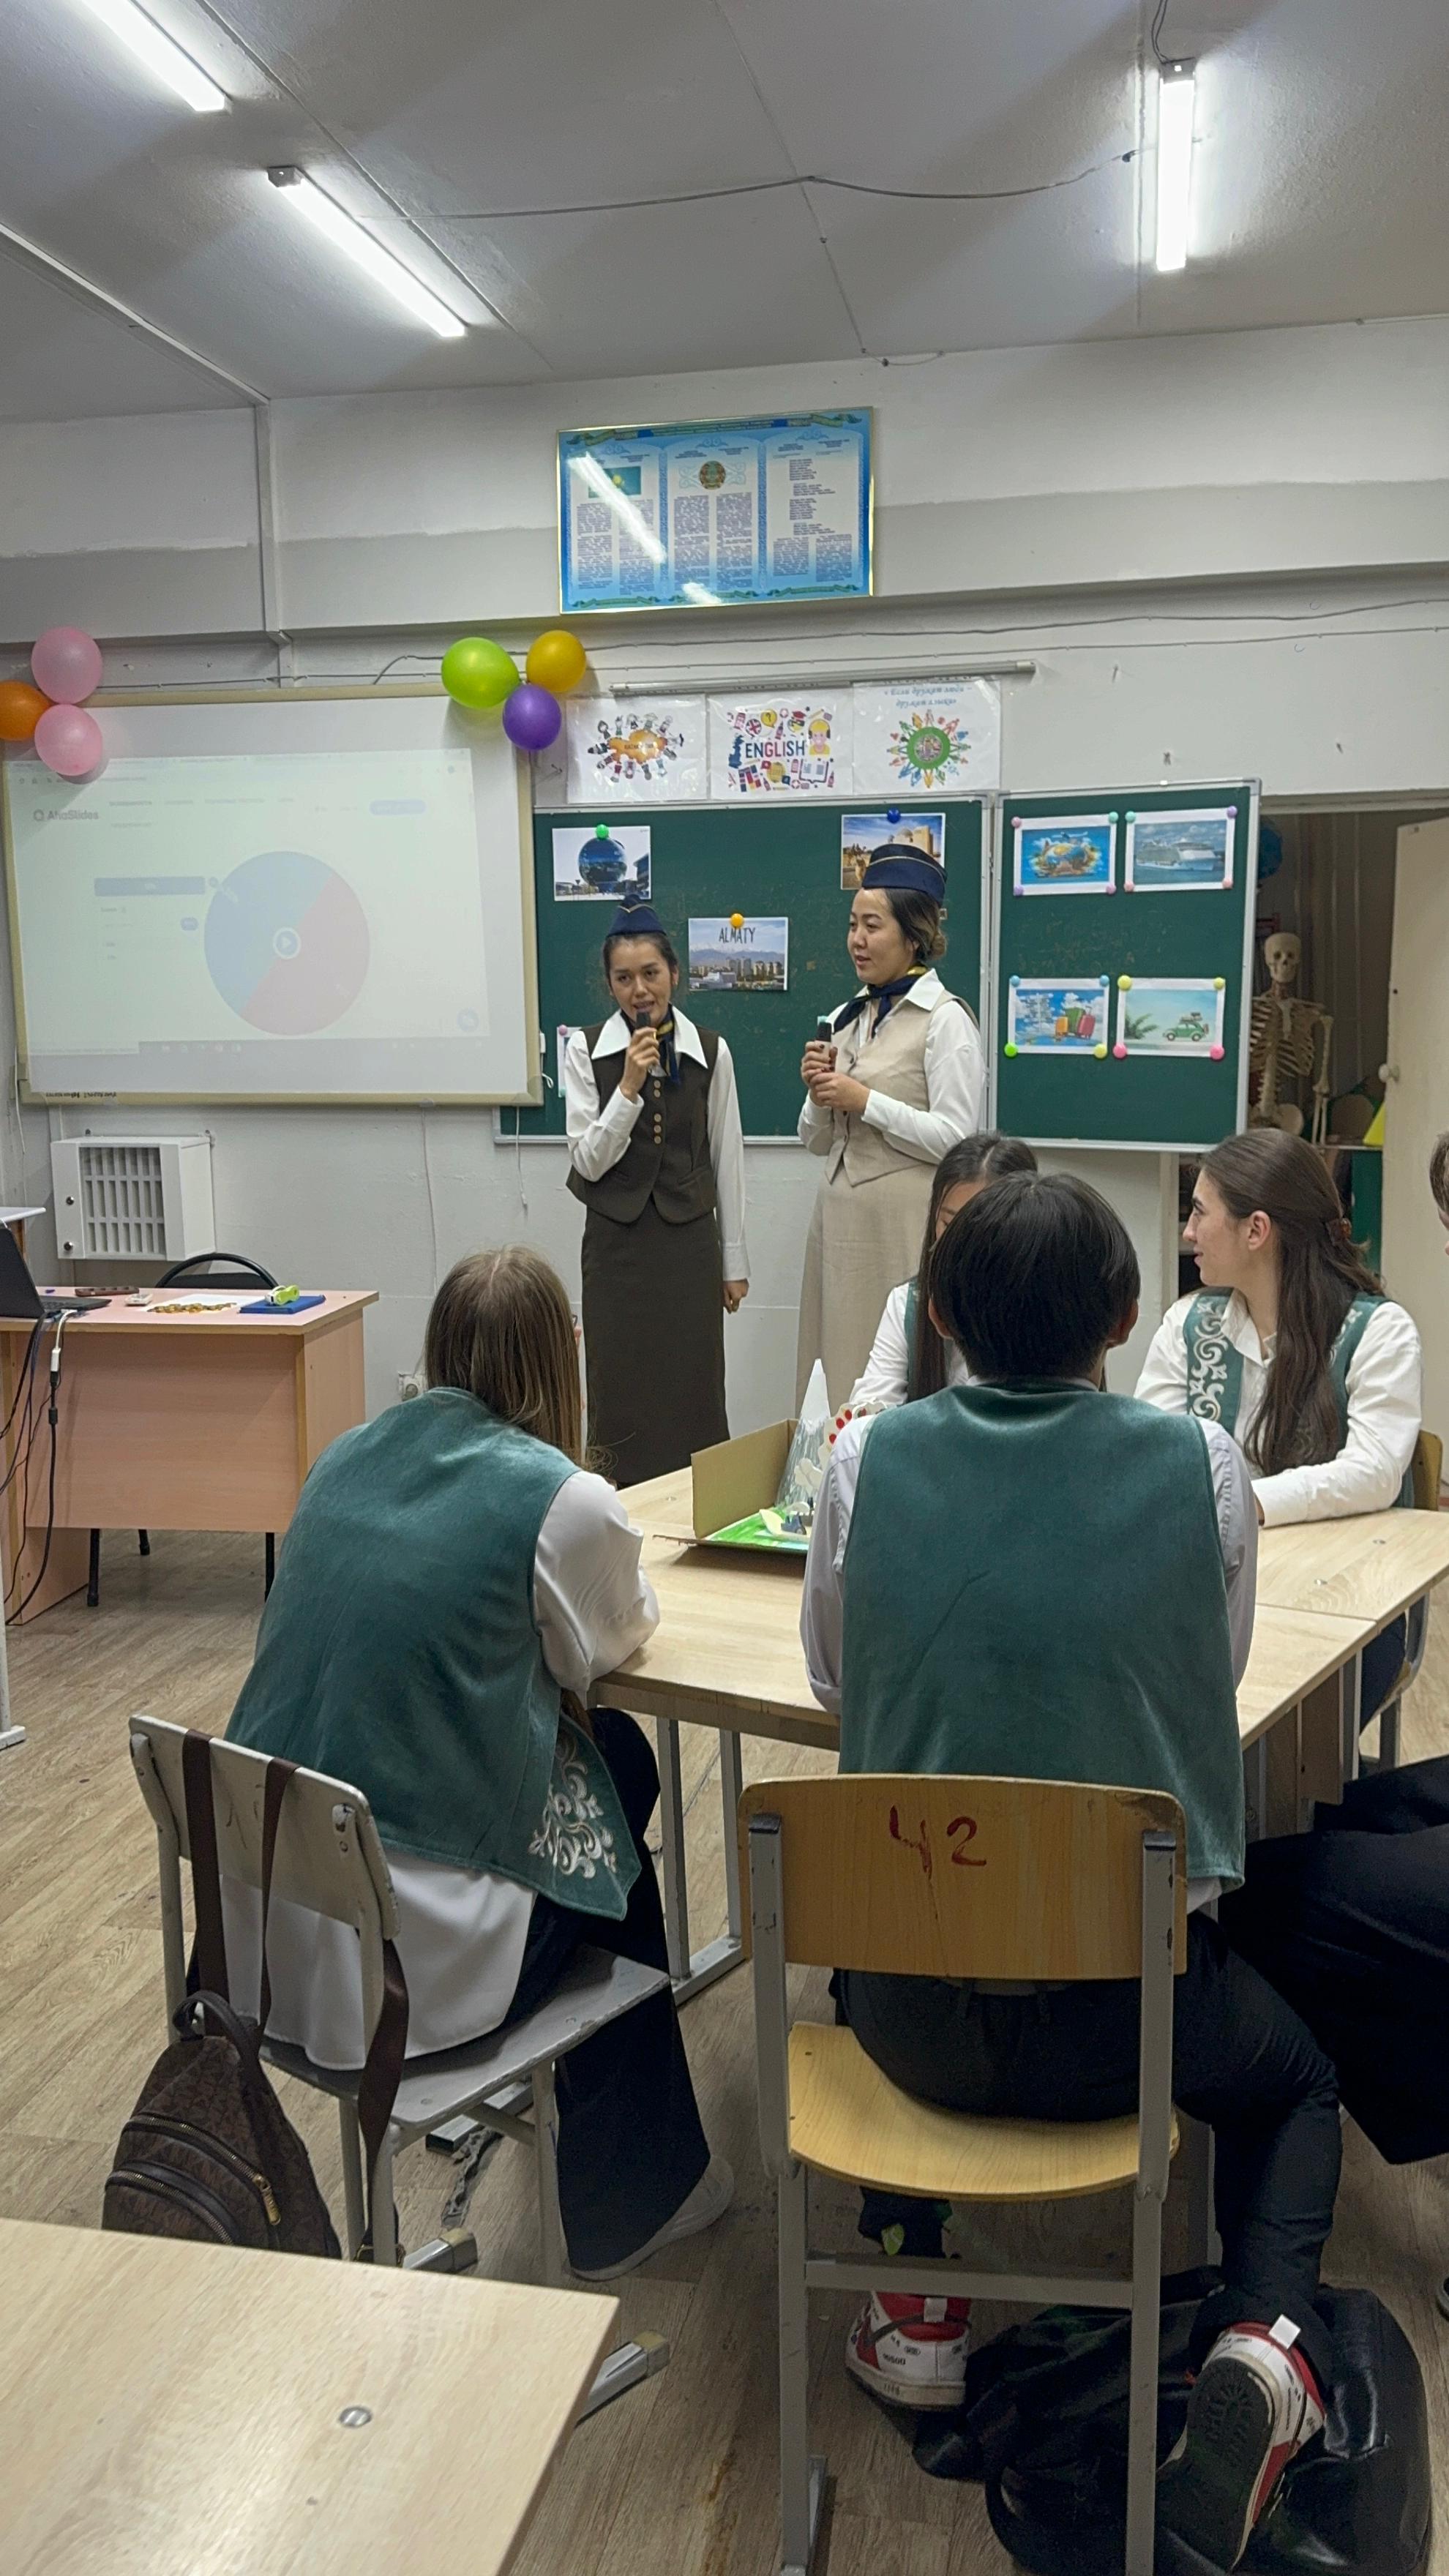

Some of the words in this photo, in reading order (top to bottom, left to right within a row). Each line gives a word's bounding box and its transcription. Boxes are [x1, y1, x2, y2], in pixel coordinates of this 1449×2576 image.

[745, 741, 805, 758] ENGLISH
[46, 810, 100, 820] AhaSlides
[719, 926, 756, 944] ALMATY
[889, 1805, 987, 1884] 42
